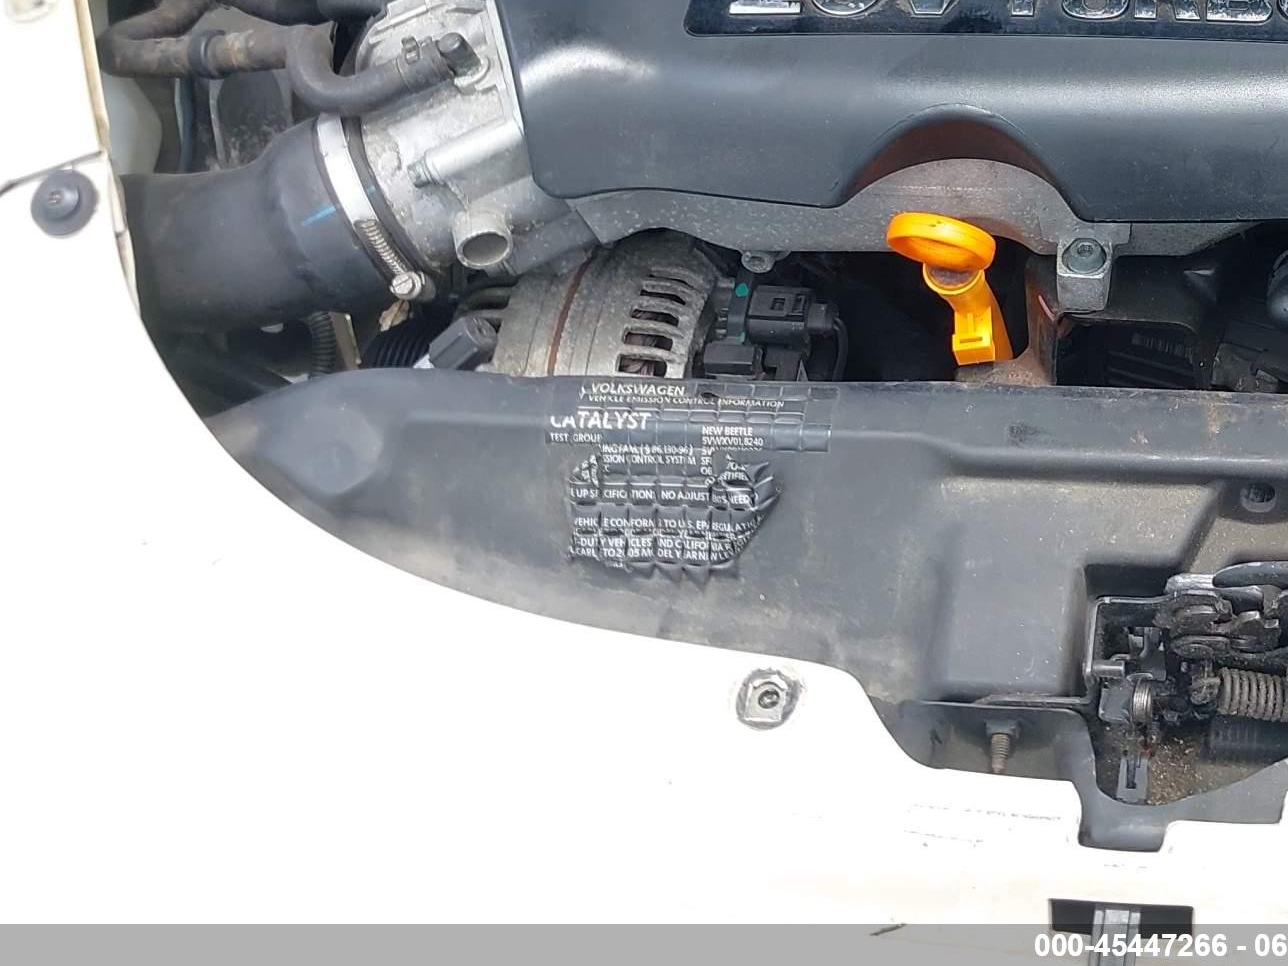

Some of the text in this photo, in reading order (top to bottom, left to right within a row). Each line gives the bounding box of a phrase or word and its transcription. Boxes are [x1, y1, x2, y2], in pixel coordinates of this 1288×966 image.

[592, 383, 685, 396] VOLKSWAGEN
[702, 426, 753, 436] NEW BEETLE
[550, 433, 569, 442] TEST
[661, 490, 675, 499] NO
